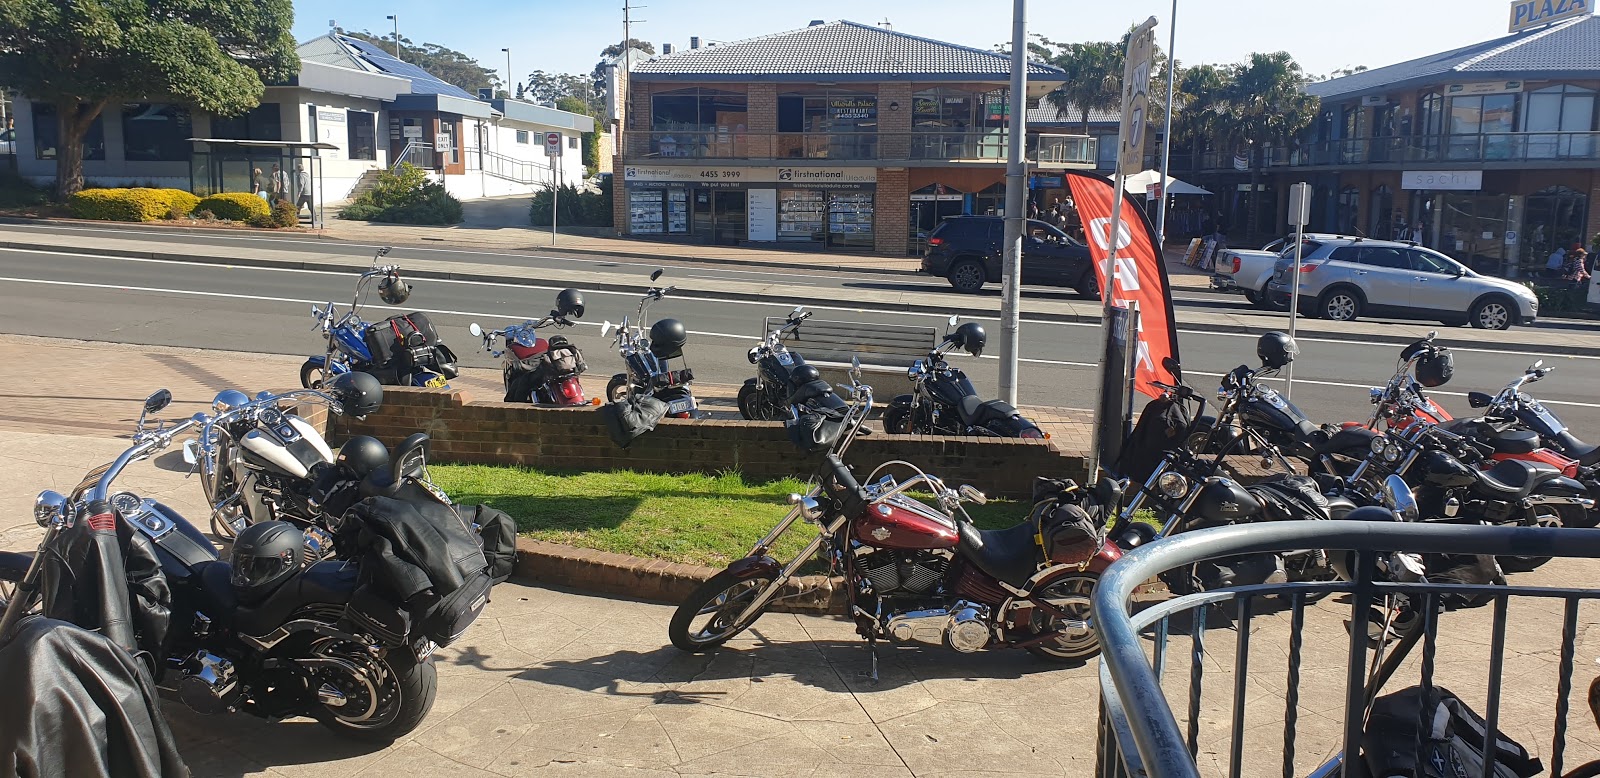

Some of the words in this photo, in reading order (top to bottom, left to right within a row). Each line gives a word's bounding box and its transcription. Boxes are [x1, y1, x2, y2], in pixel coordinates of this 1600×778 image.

[1513, 0, 1586, 26] PLAZA
[699, 170, 719, 178] 4455
[722, 170, 741, 178] 3999
[794, 170, 844, 178] firstnational
[1415, 171, 1468, 185] sachi
